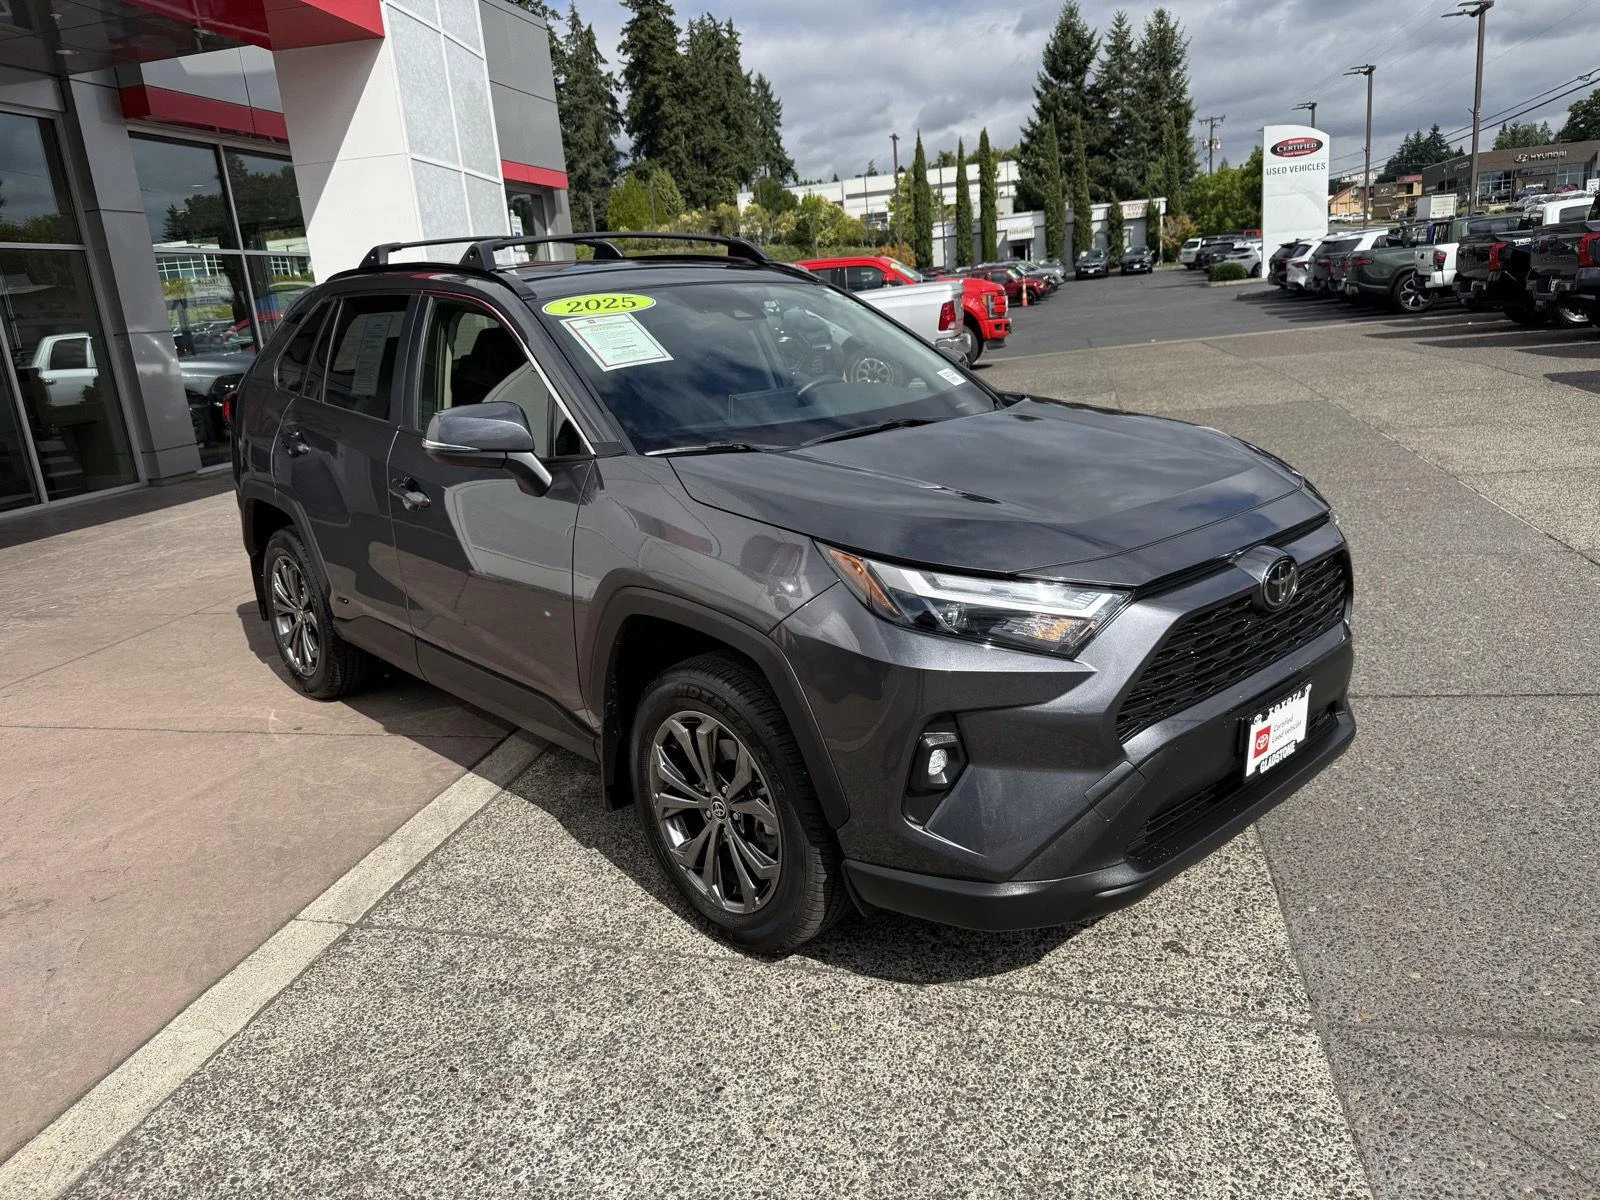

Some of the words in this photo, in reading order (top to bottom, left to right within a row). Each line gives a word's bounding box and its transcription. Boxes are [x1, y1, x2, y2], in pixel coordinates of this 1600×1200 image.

[1276, 142, 1318, 153] CERTIFIED
[1530, 150, 1567, 160] HYUNDAI
[1266, 166, 1287, 175] USED
[1289, 162, 1326, 173] VEHICLES
[566, 296, 637, 314] 2025
[1268, 691, 1301, 713] TOYOTA
[1273, 713, 1294, 732] Certified
[1272, 731, 1284, 744] Used
[1260, 741, 1295, 774] GLADSTONE
